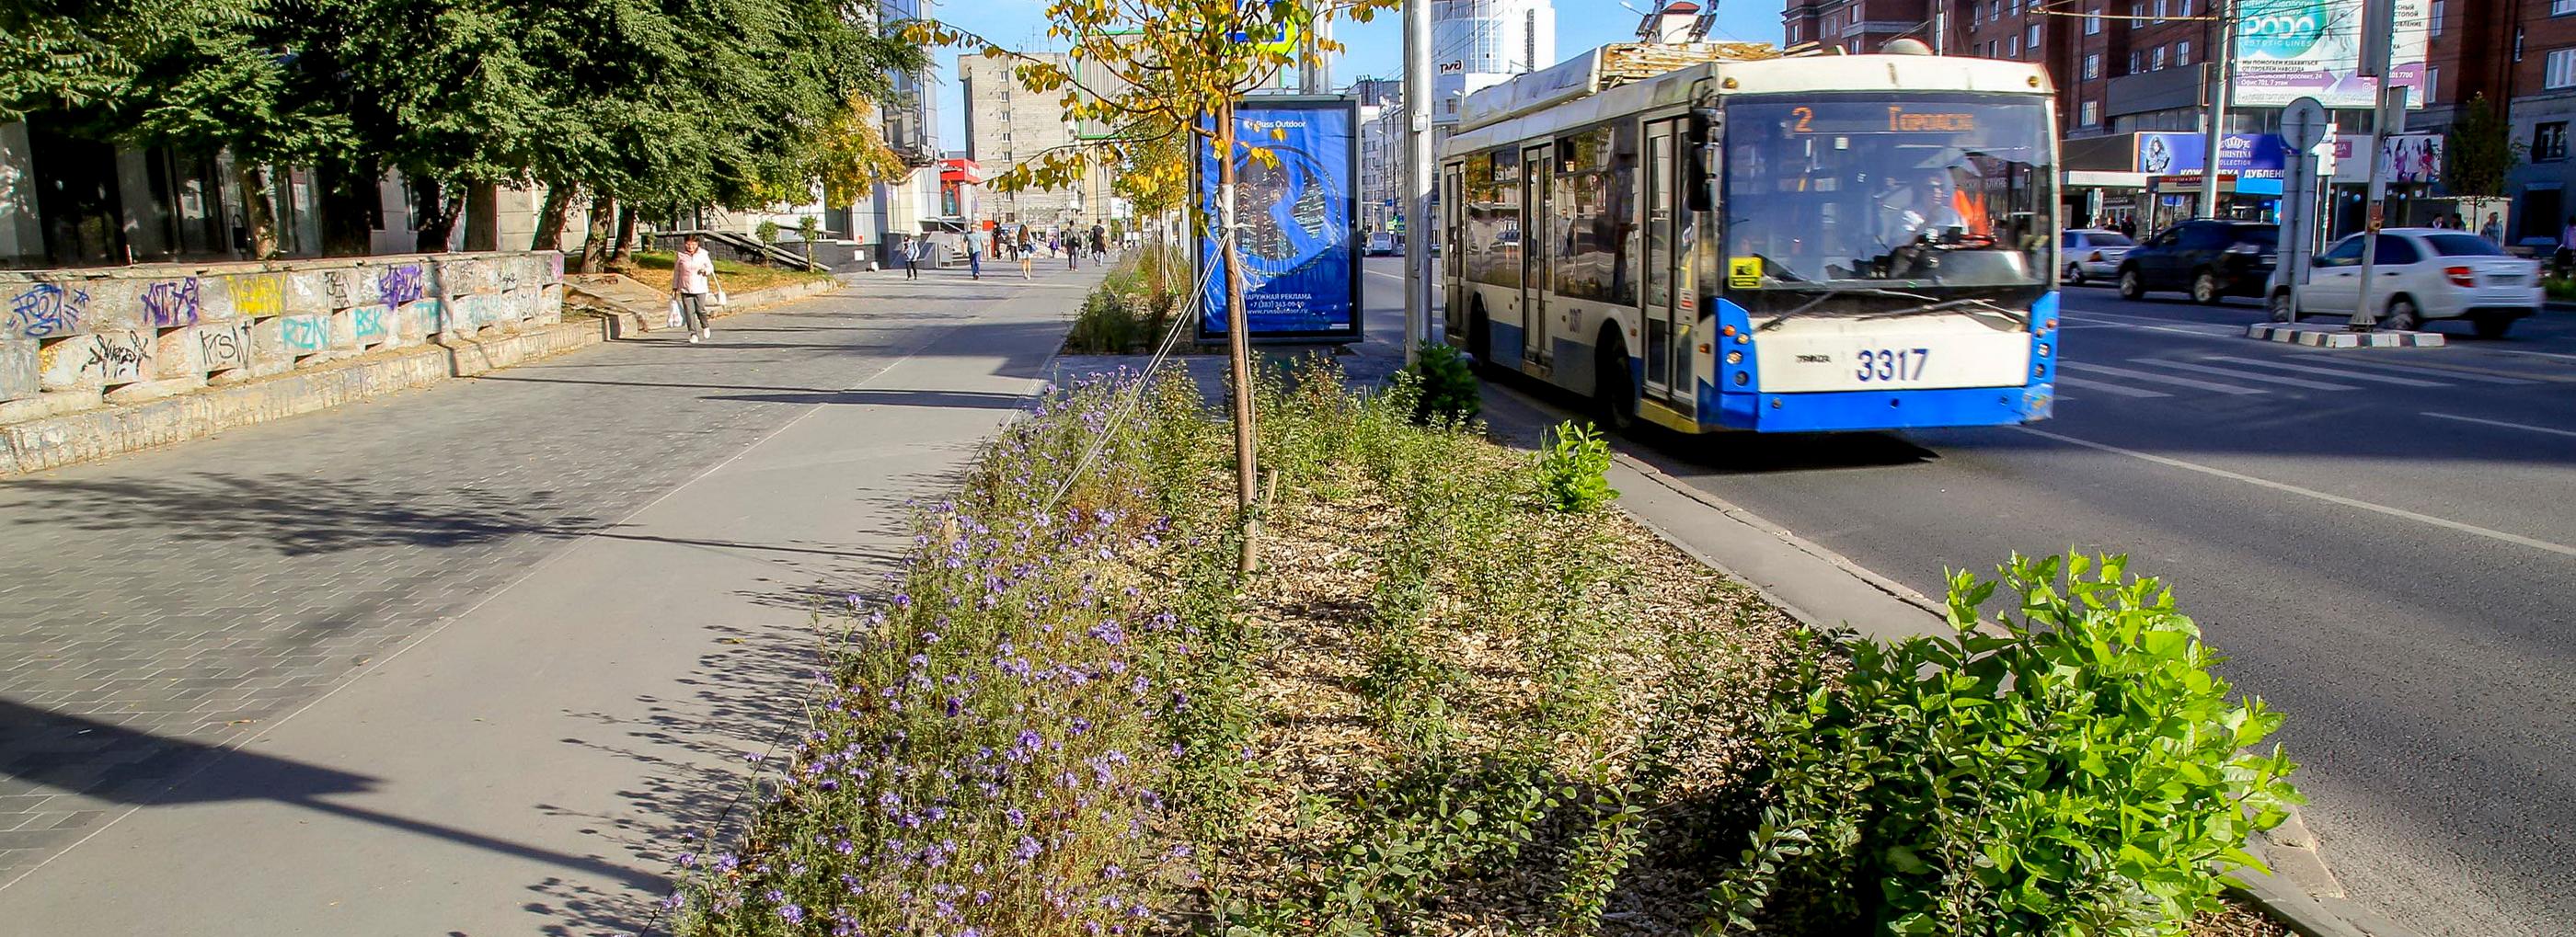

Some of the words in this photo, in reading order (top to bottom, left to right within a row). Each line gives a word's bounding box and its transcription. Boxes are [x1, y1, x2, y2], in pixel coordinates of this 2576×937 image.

[1792, 106, 1813, 132] 2
[2219, 150, 2251, 158] HRISTINA
[1856, 348, 1930, 382] 3317
